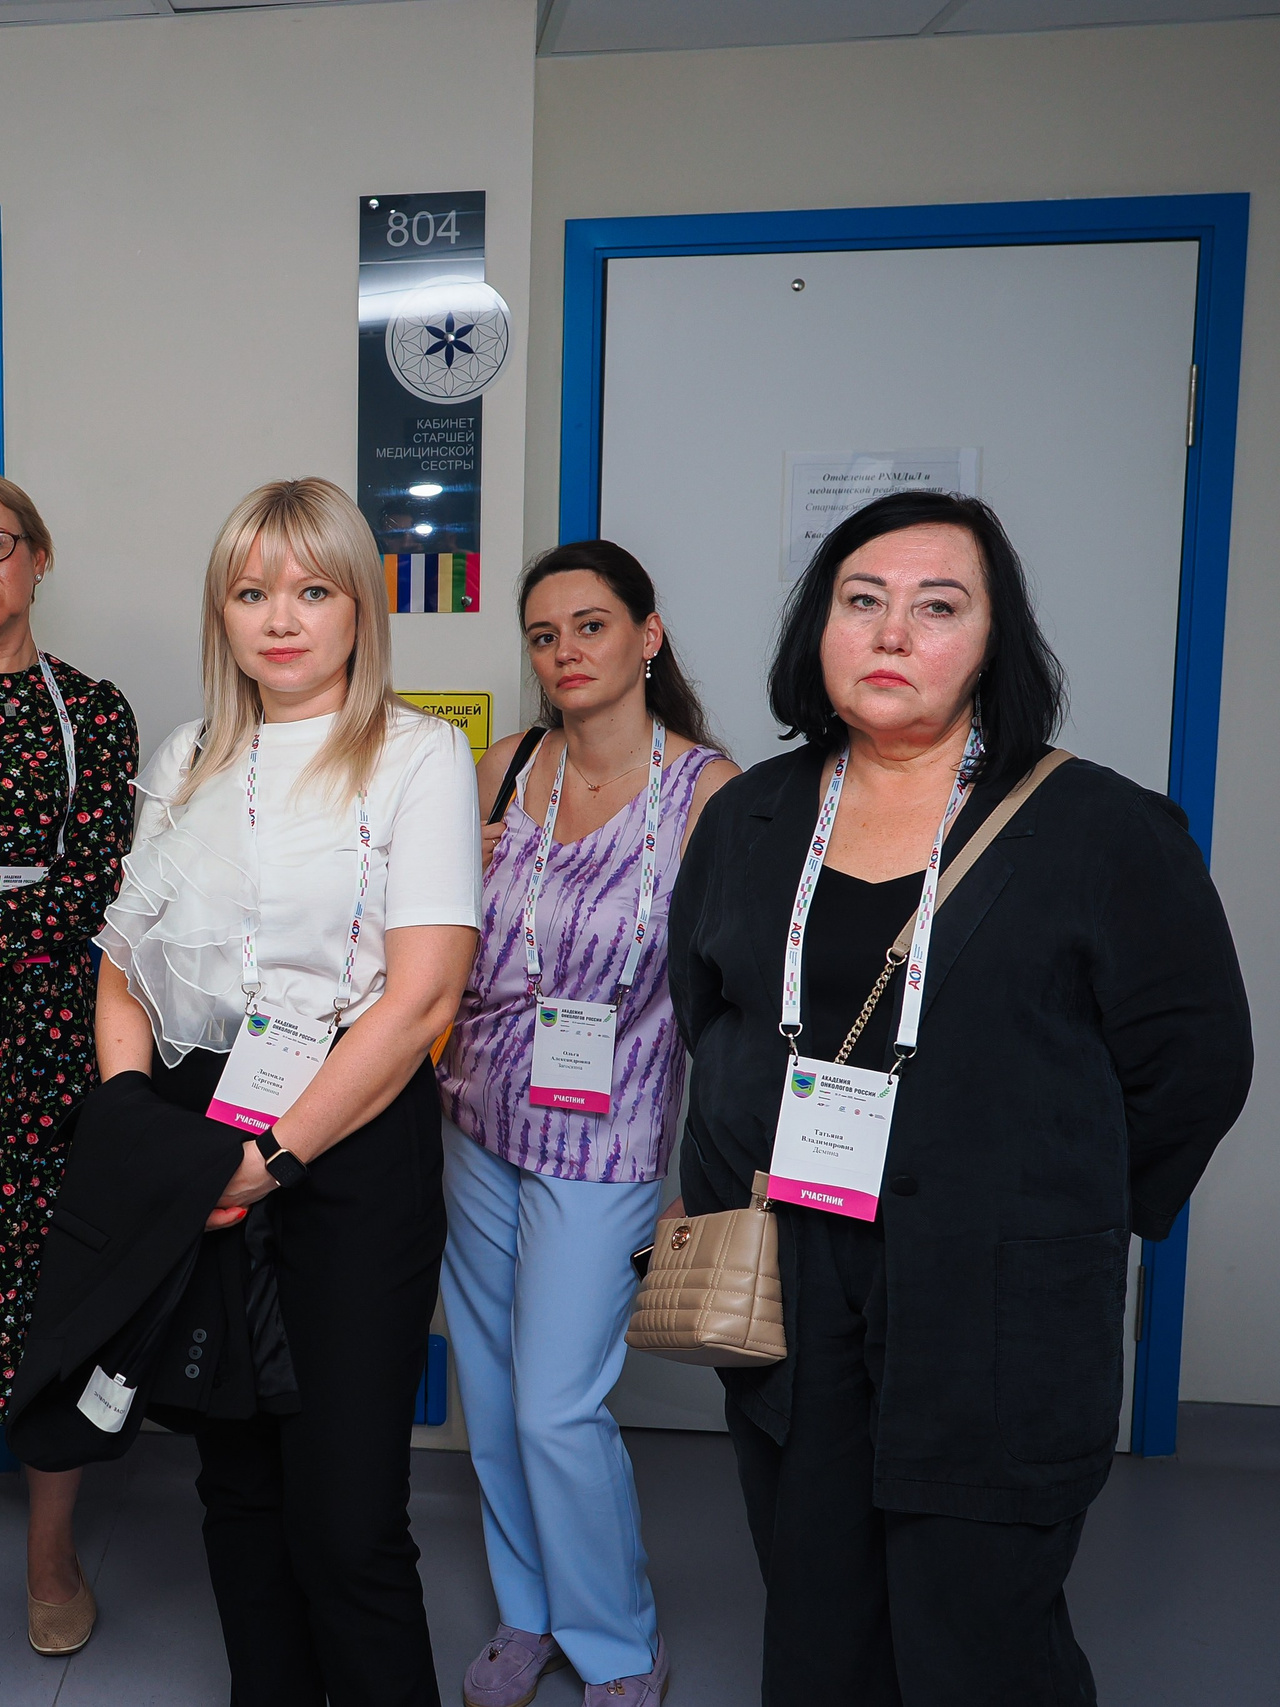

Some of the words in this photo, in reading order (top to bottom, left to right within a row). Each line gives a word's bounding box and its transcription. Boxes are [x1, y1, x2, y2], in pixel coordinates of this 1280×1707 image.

[386, 209, 460, 248] 804
[417, 417, 474, 429] КАБИНЕТ
[413, 428, 475, 443] СТАРШЕЙ
[376, 443, 475, 459] МЕДИЦИНСКОЙ
[420, 459, 474, 471] СЕСТРЫ
[822, 473, 876, 482] Отделение
[807, 484, 871, 496] медицинской
[298, 1033, 317, 1043] РОССИИ
[821, 1075, 851, 1086] АКАДЕМИЯ
[820, 1081, 853, 1093] ОНКОЛОГОВ
[853, 1088, 877, 1098] РОССИИ
[553, 1094, 585, 1104] УЧАСТНИК
[234, 1112, 271, 1131] УЧАСТНИК
[814, 1128, 844, 1141] Татьяна
[801, 1135, 854, 1152] Владимировна
[800, 1189, 844, 1207] УЧАСТНИК
